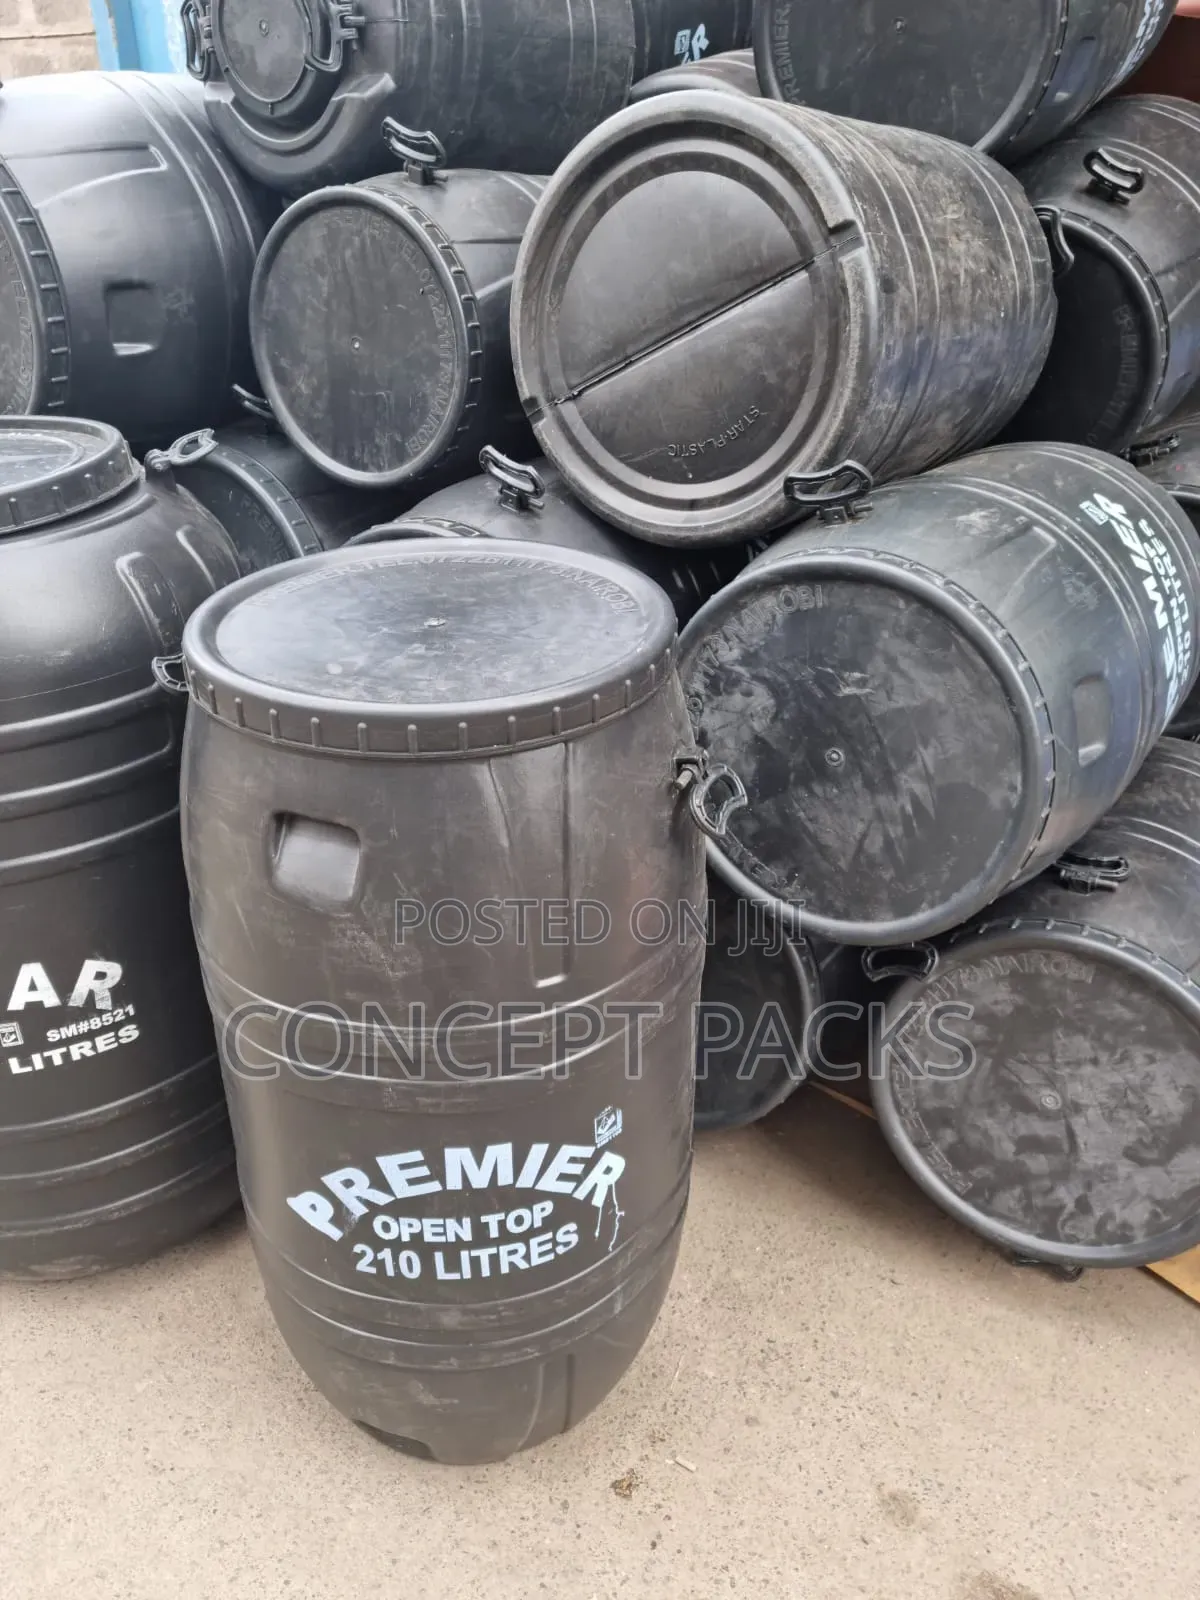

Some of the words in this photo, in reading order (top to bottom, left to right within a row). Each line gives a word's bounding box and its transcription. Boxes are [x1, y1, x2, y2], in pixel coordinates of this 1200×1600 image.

[46, 1003, 136, 1042] SM#8521
[8, 1023, 141, 1075] LITRES
[286, 1141, 626, 1242] PREMIER
[372, 1214, 472, 1243] OPEN
[480, 1200, 554, 1239] TOP
[352, 1242, 422, 1280] 210
[433, 1221, 580, 1281] LITRES
